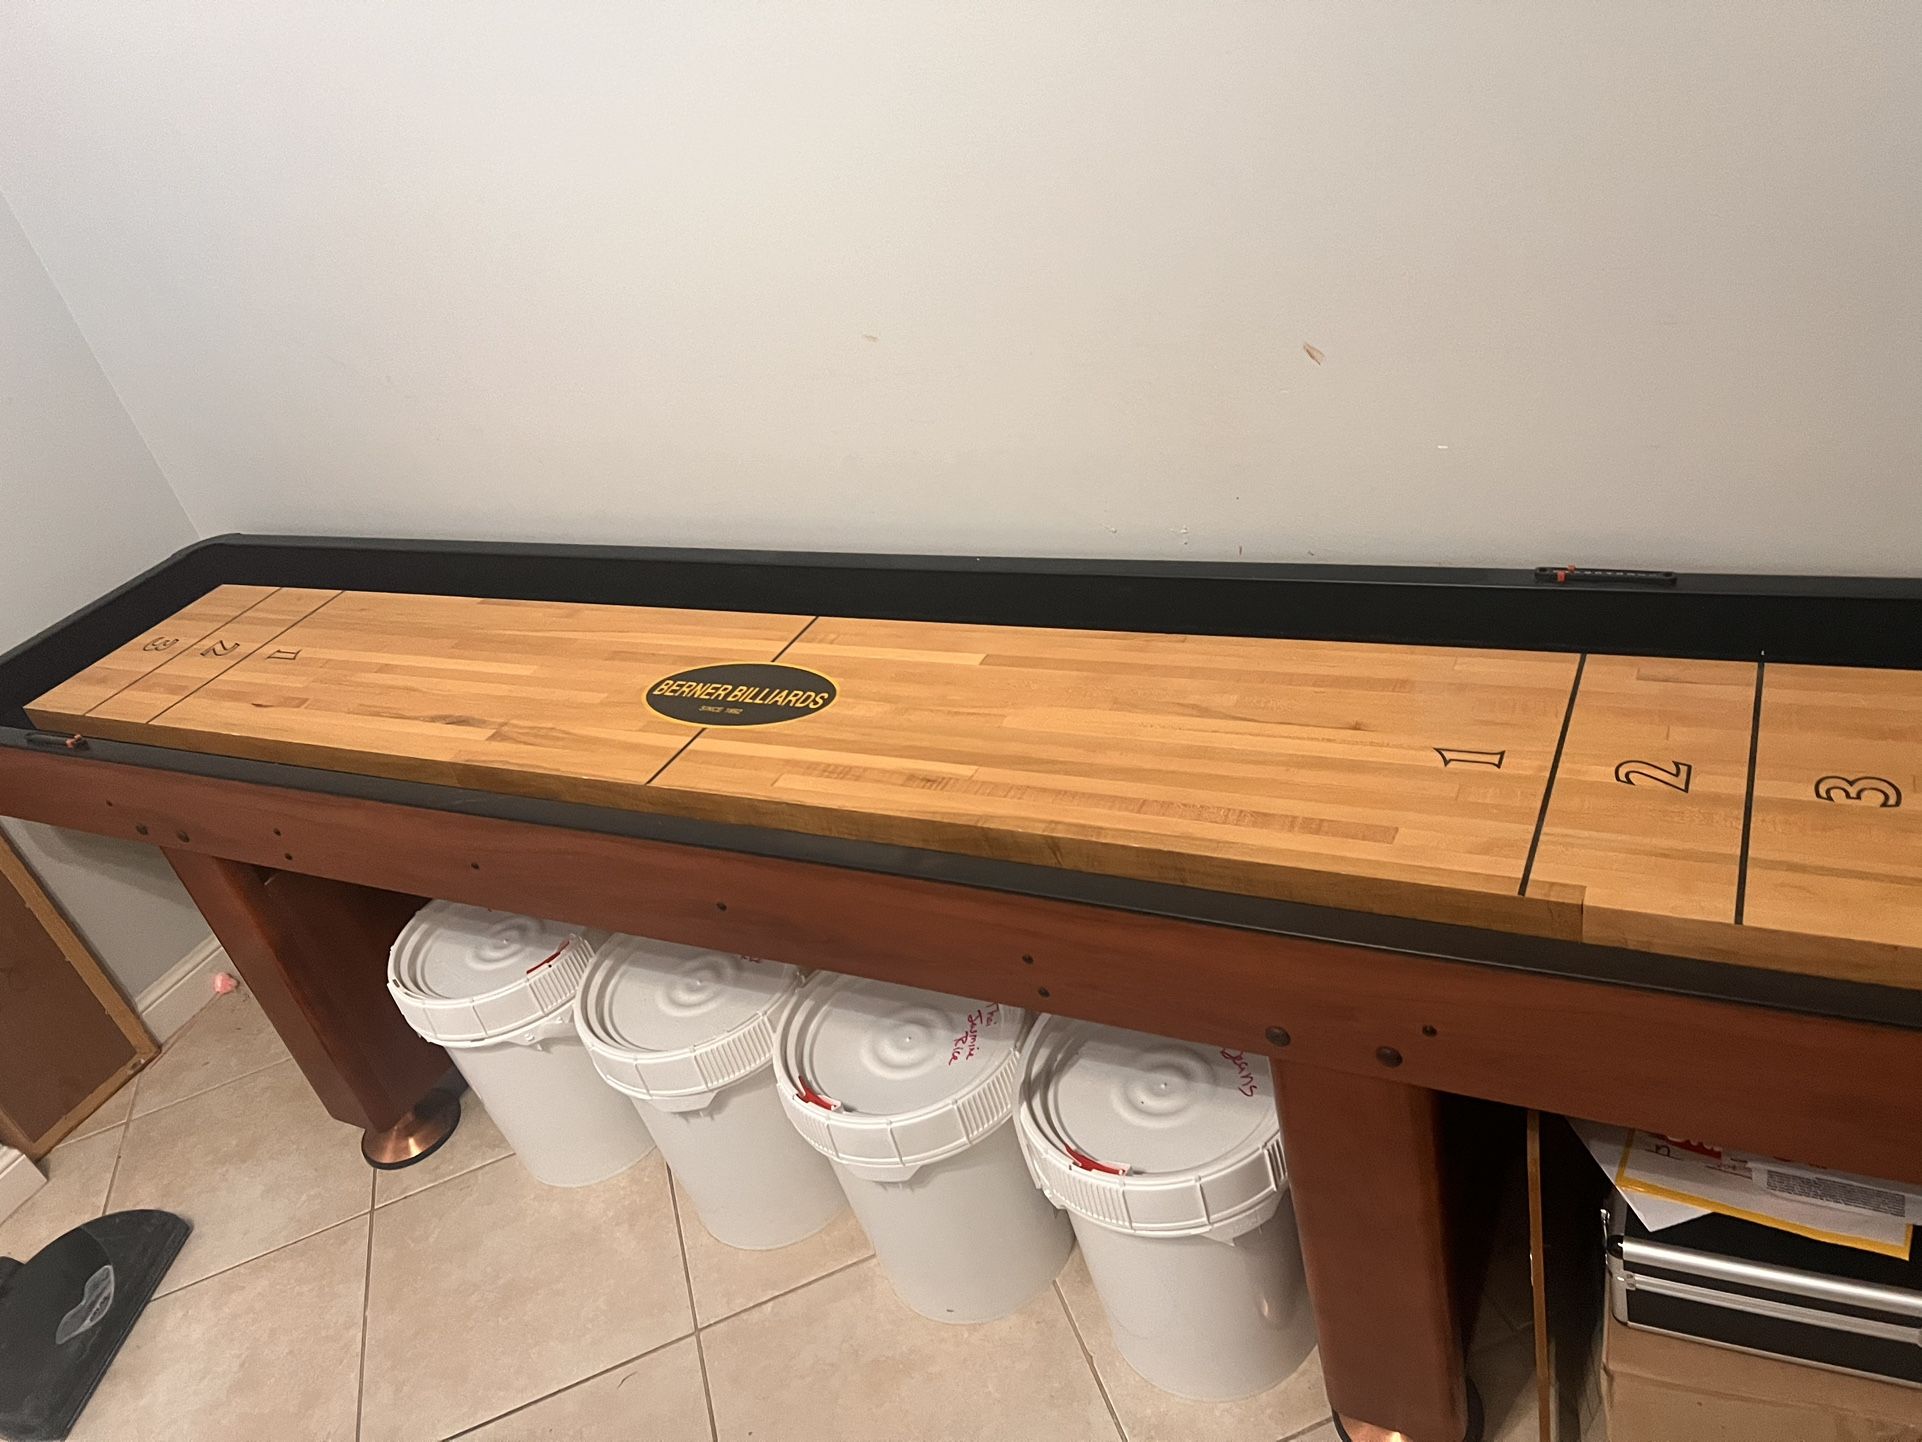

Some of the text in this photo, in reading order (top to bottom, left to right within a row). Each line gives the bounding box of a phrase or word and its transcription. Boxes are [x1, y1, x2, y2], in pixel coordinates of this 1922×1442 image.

[142, 636, 180, 652] 3
[199, 639, 241, 657] 2
[265, 648, 303, 661] 1
[652, 679, 829, 709] BERNER BILLIARDS
[698, 705, 725, 713] SINCE
[1433, 747, 1506, 769] 1
[1614, 759, 1693, 793] 2
[1814, 774, 1903, 808] 3
[948, 1030, 968, 1066] Rice
